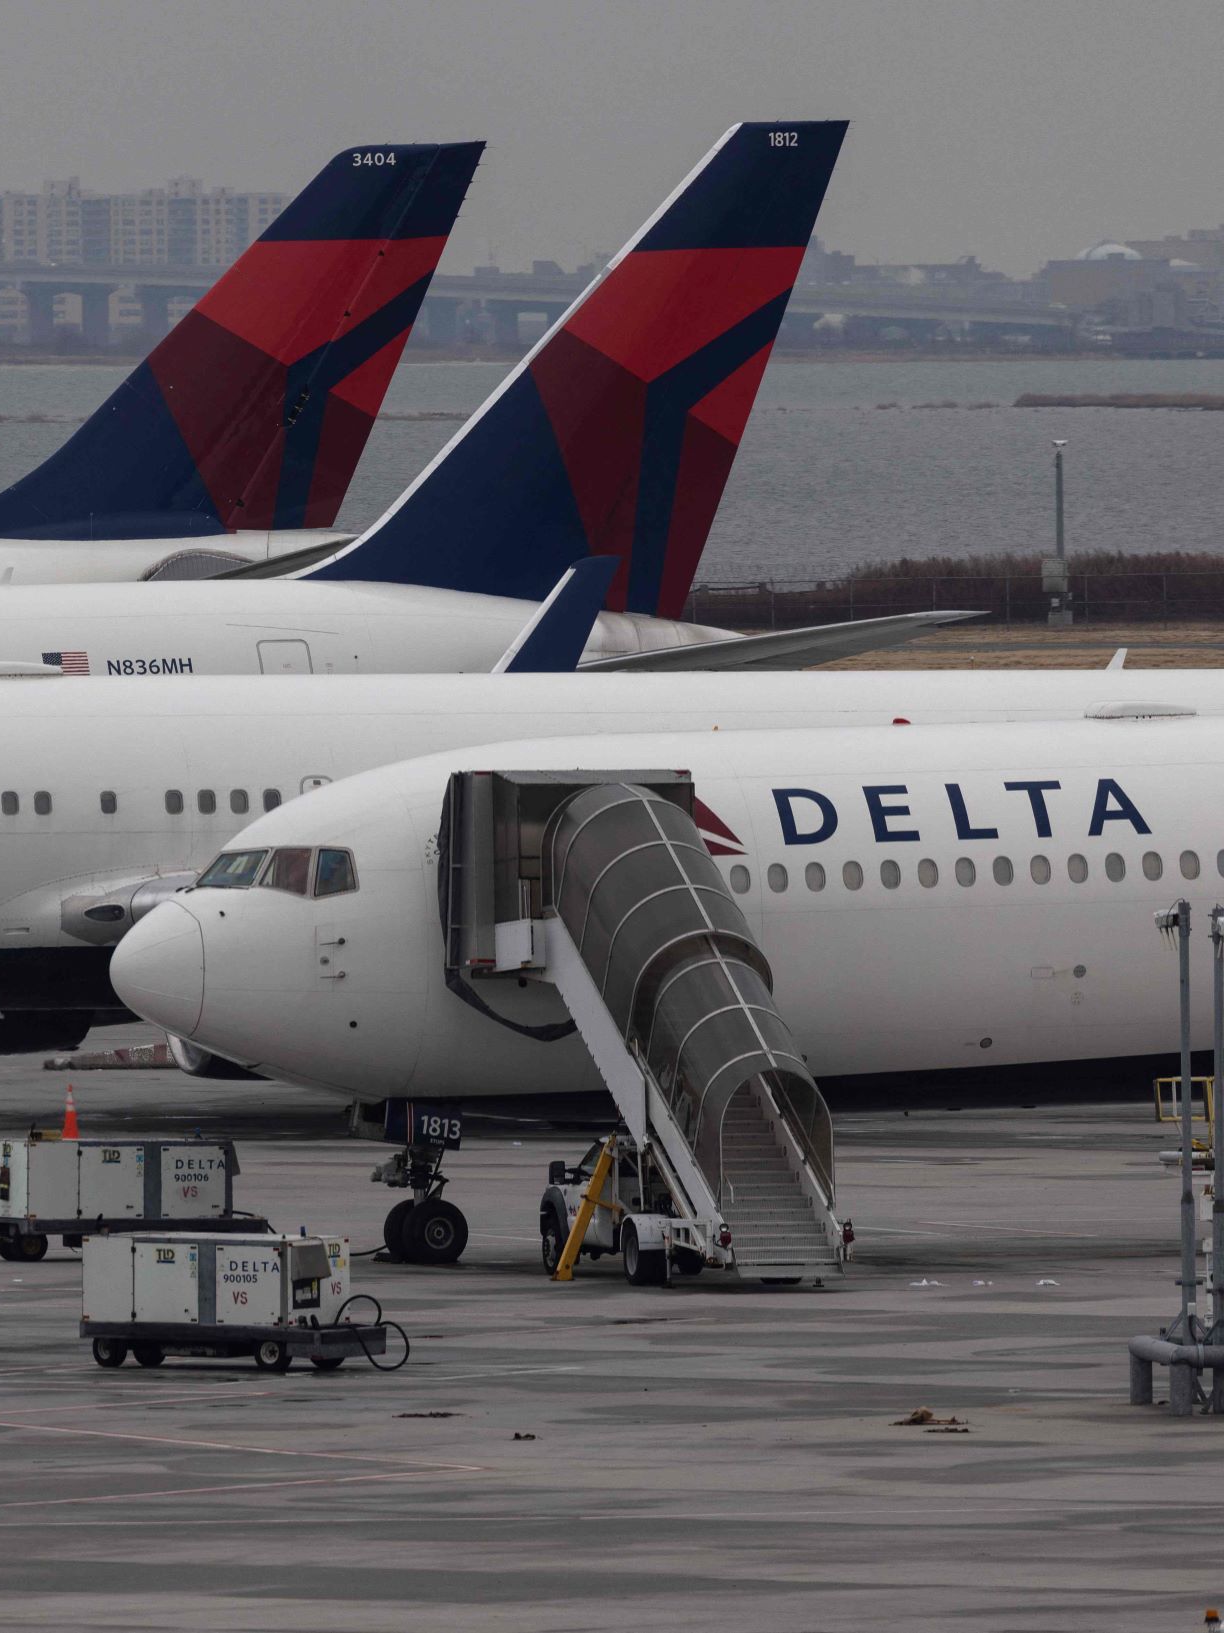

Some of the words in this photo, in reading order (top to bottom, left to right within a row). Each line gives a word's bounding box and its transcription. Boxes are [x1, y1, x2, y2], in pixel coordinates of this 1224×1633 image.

[768, 132, 798, 147] 1812
[352, 152, 396, 166] 3404
[107, 657, 193, 676] N836MH
[771, 778, 1152, 845] DELTA
[425, 833, 438, 865] SKYT
[421, 1115, 461, 1139] 1813
[102, 1149, 121, 1160] TLD
[176, 1159, 225, 1170] DELTA
[174, 1174, 209, 1182] 900106
[182, 1186, 198, 1198] VS
[156, 1249, 175, 1260] TLD
[229, 1261, 280, 1273] DELTA
[223, 1274, 258, 1283] 900105
[330, 1282, 342, 1295] VS
[232, 1291, 248, 1305] VS
